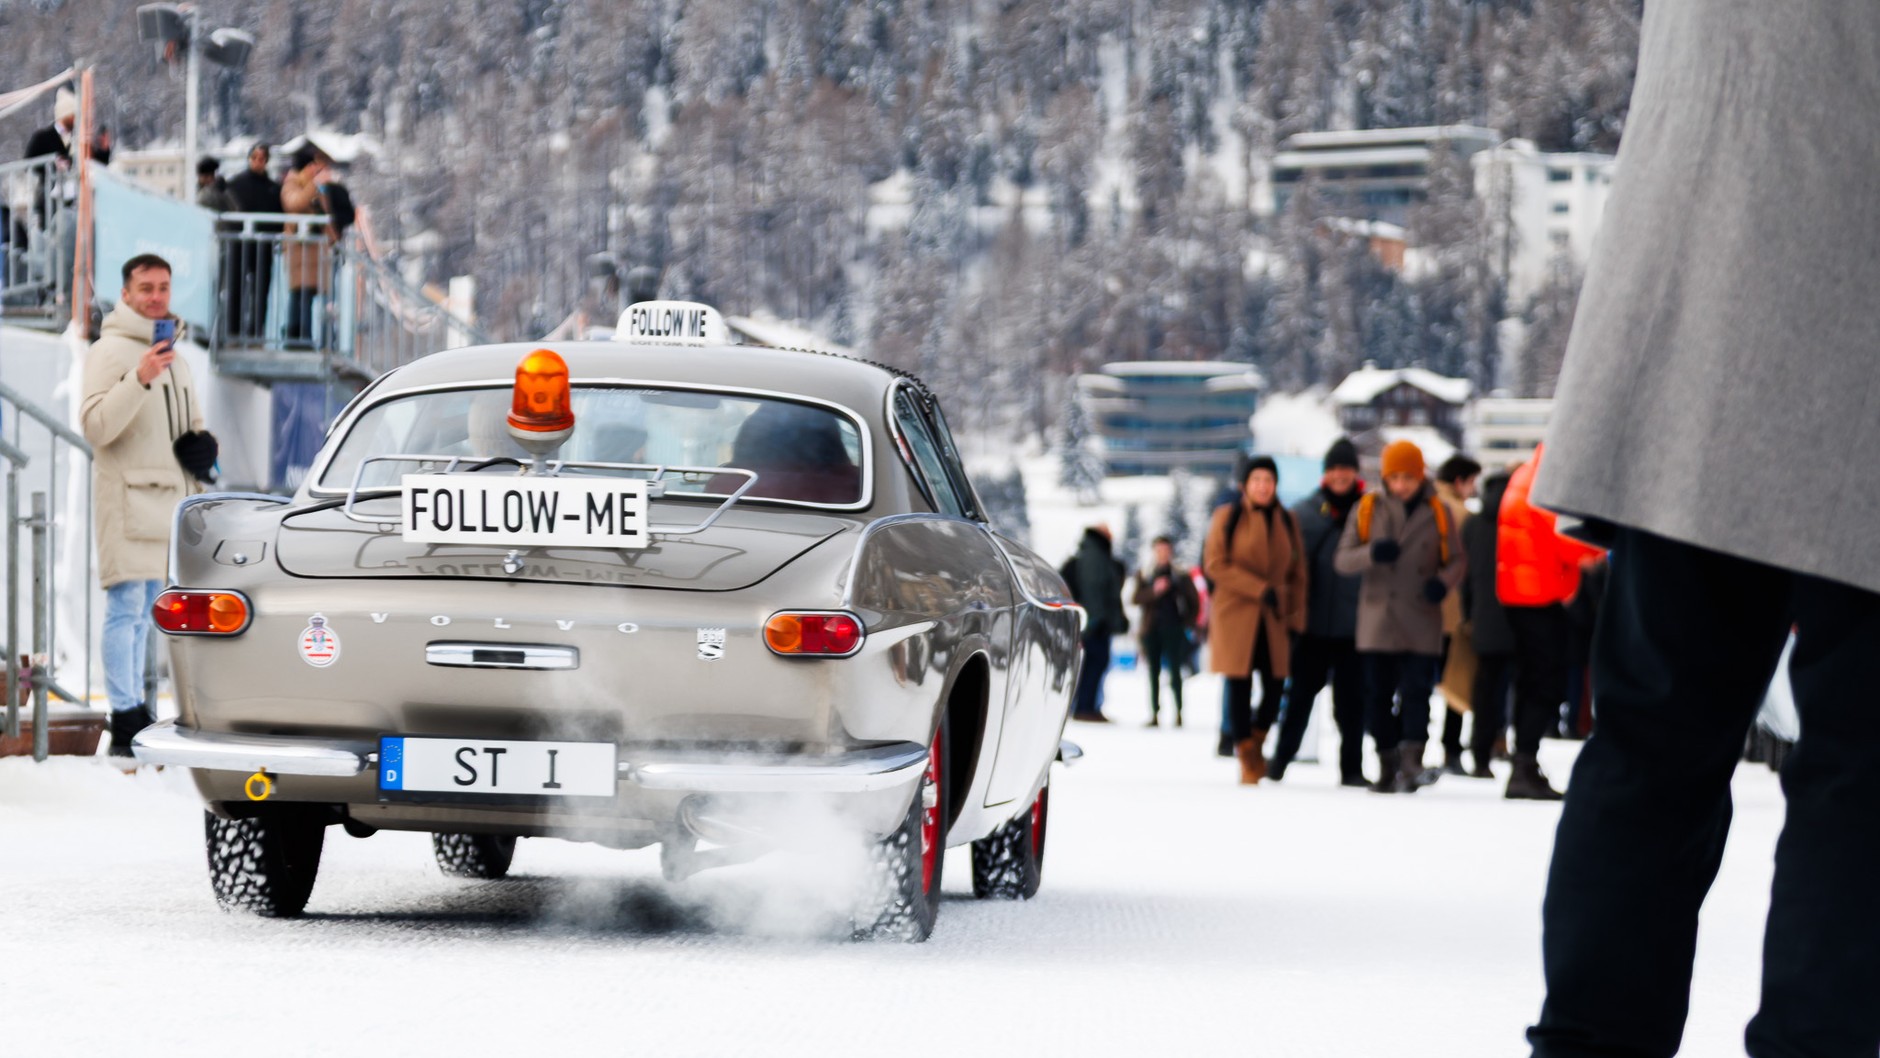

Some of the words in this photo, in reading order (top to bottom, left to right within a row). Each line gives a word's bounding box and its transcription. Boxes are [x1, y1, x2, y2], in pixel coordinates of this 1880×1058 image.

[630, 308, 684, 336] FOLLOW
[687, 309, 707, 337] ME
[411, 487, 638, 536] FOLLOW-ME
[386, 769, 398, 782] D
[453, 746, 508, 787] ST
